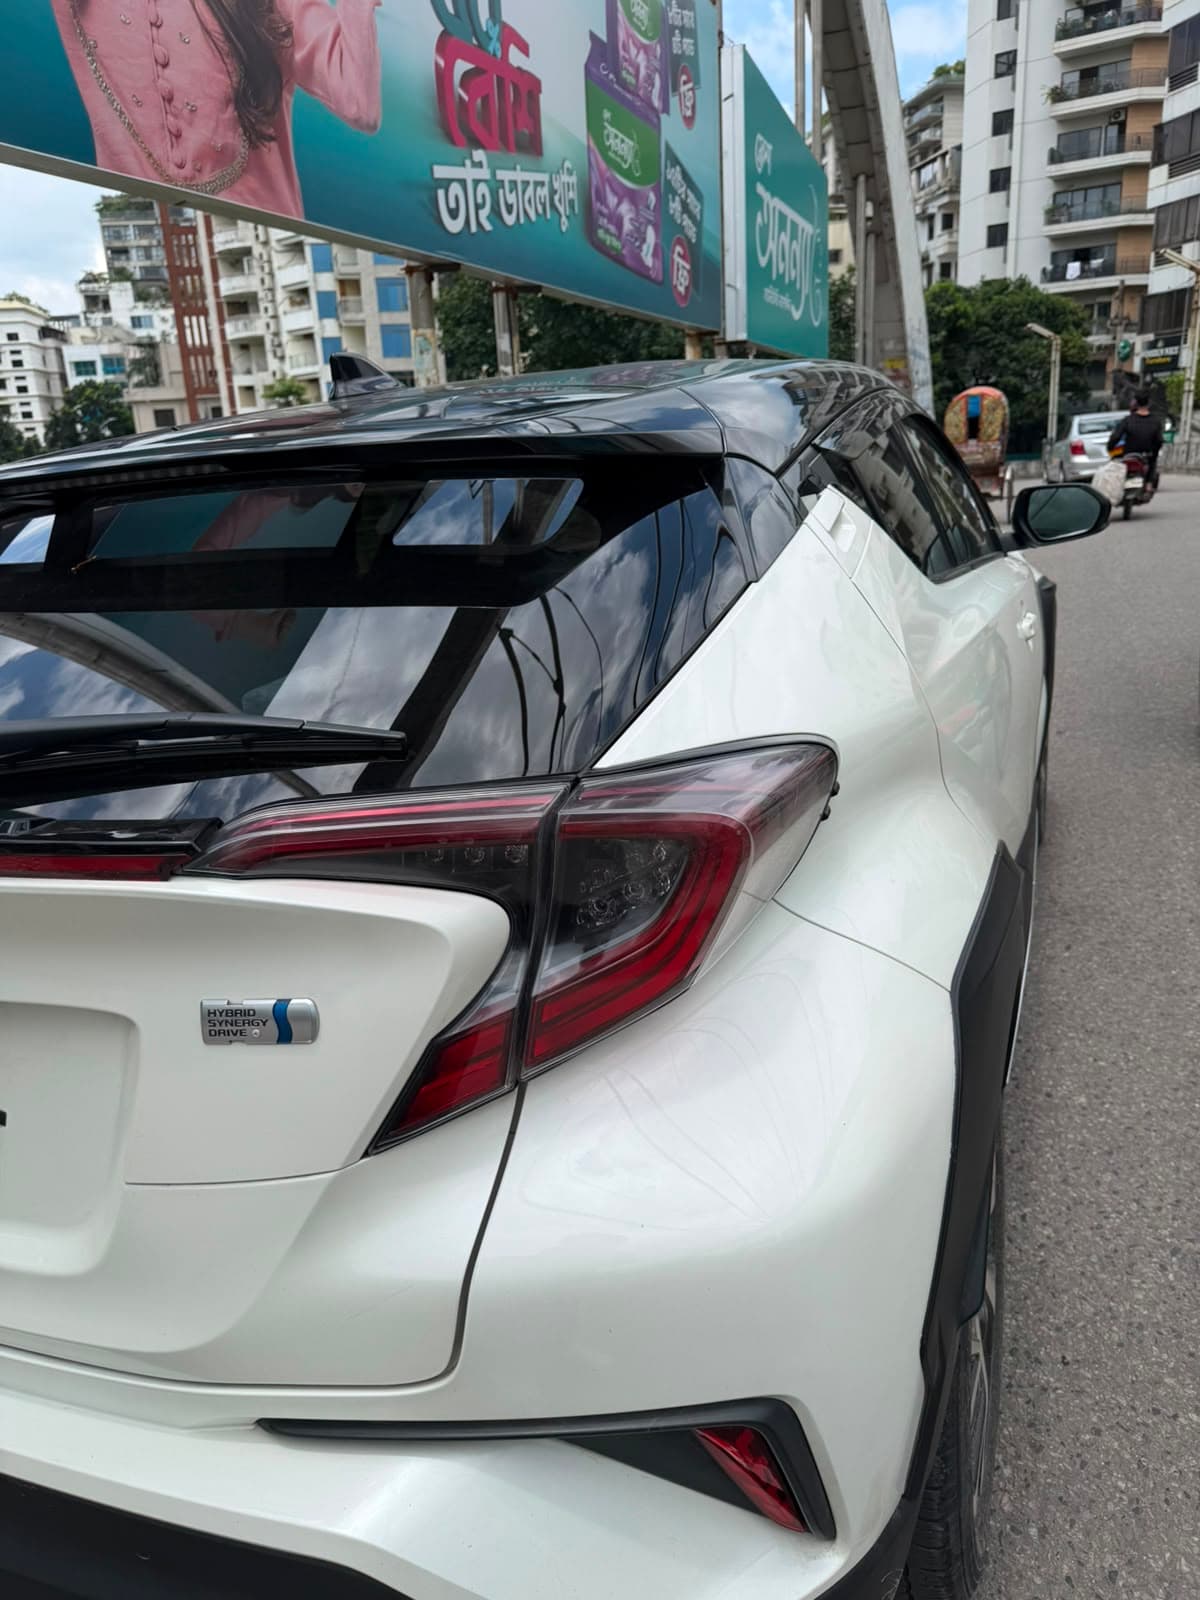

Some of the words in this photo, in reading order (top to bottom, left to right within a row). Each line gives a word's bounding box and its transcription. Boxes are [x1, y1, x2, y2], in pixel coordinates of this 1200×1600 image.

[435, 20, 544, 158] বেশি
[432, 149, 494, 234] তাই
[495, 164, 551, 227] ডাবল
[551, 159, 579, 233] খুশি
[207, 1008, 256, 1018] HYBRID
[208, 1019, 269, 1028] SYNERGY
[208, 1028, 248, 1037] DRIVE
